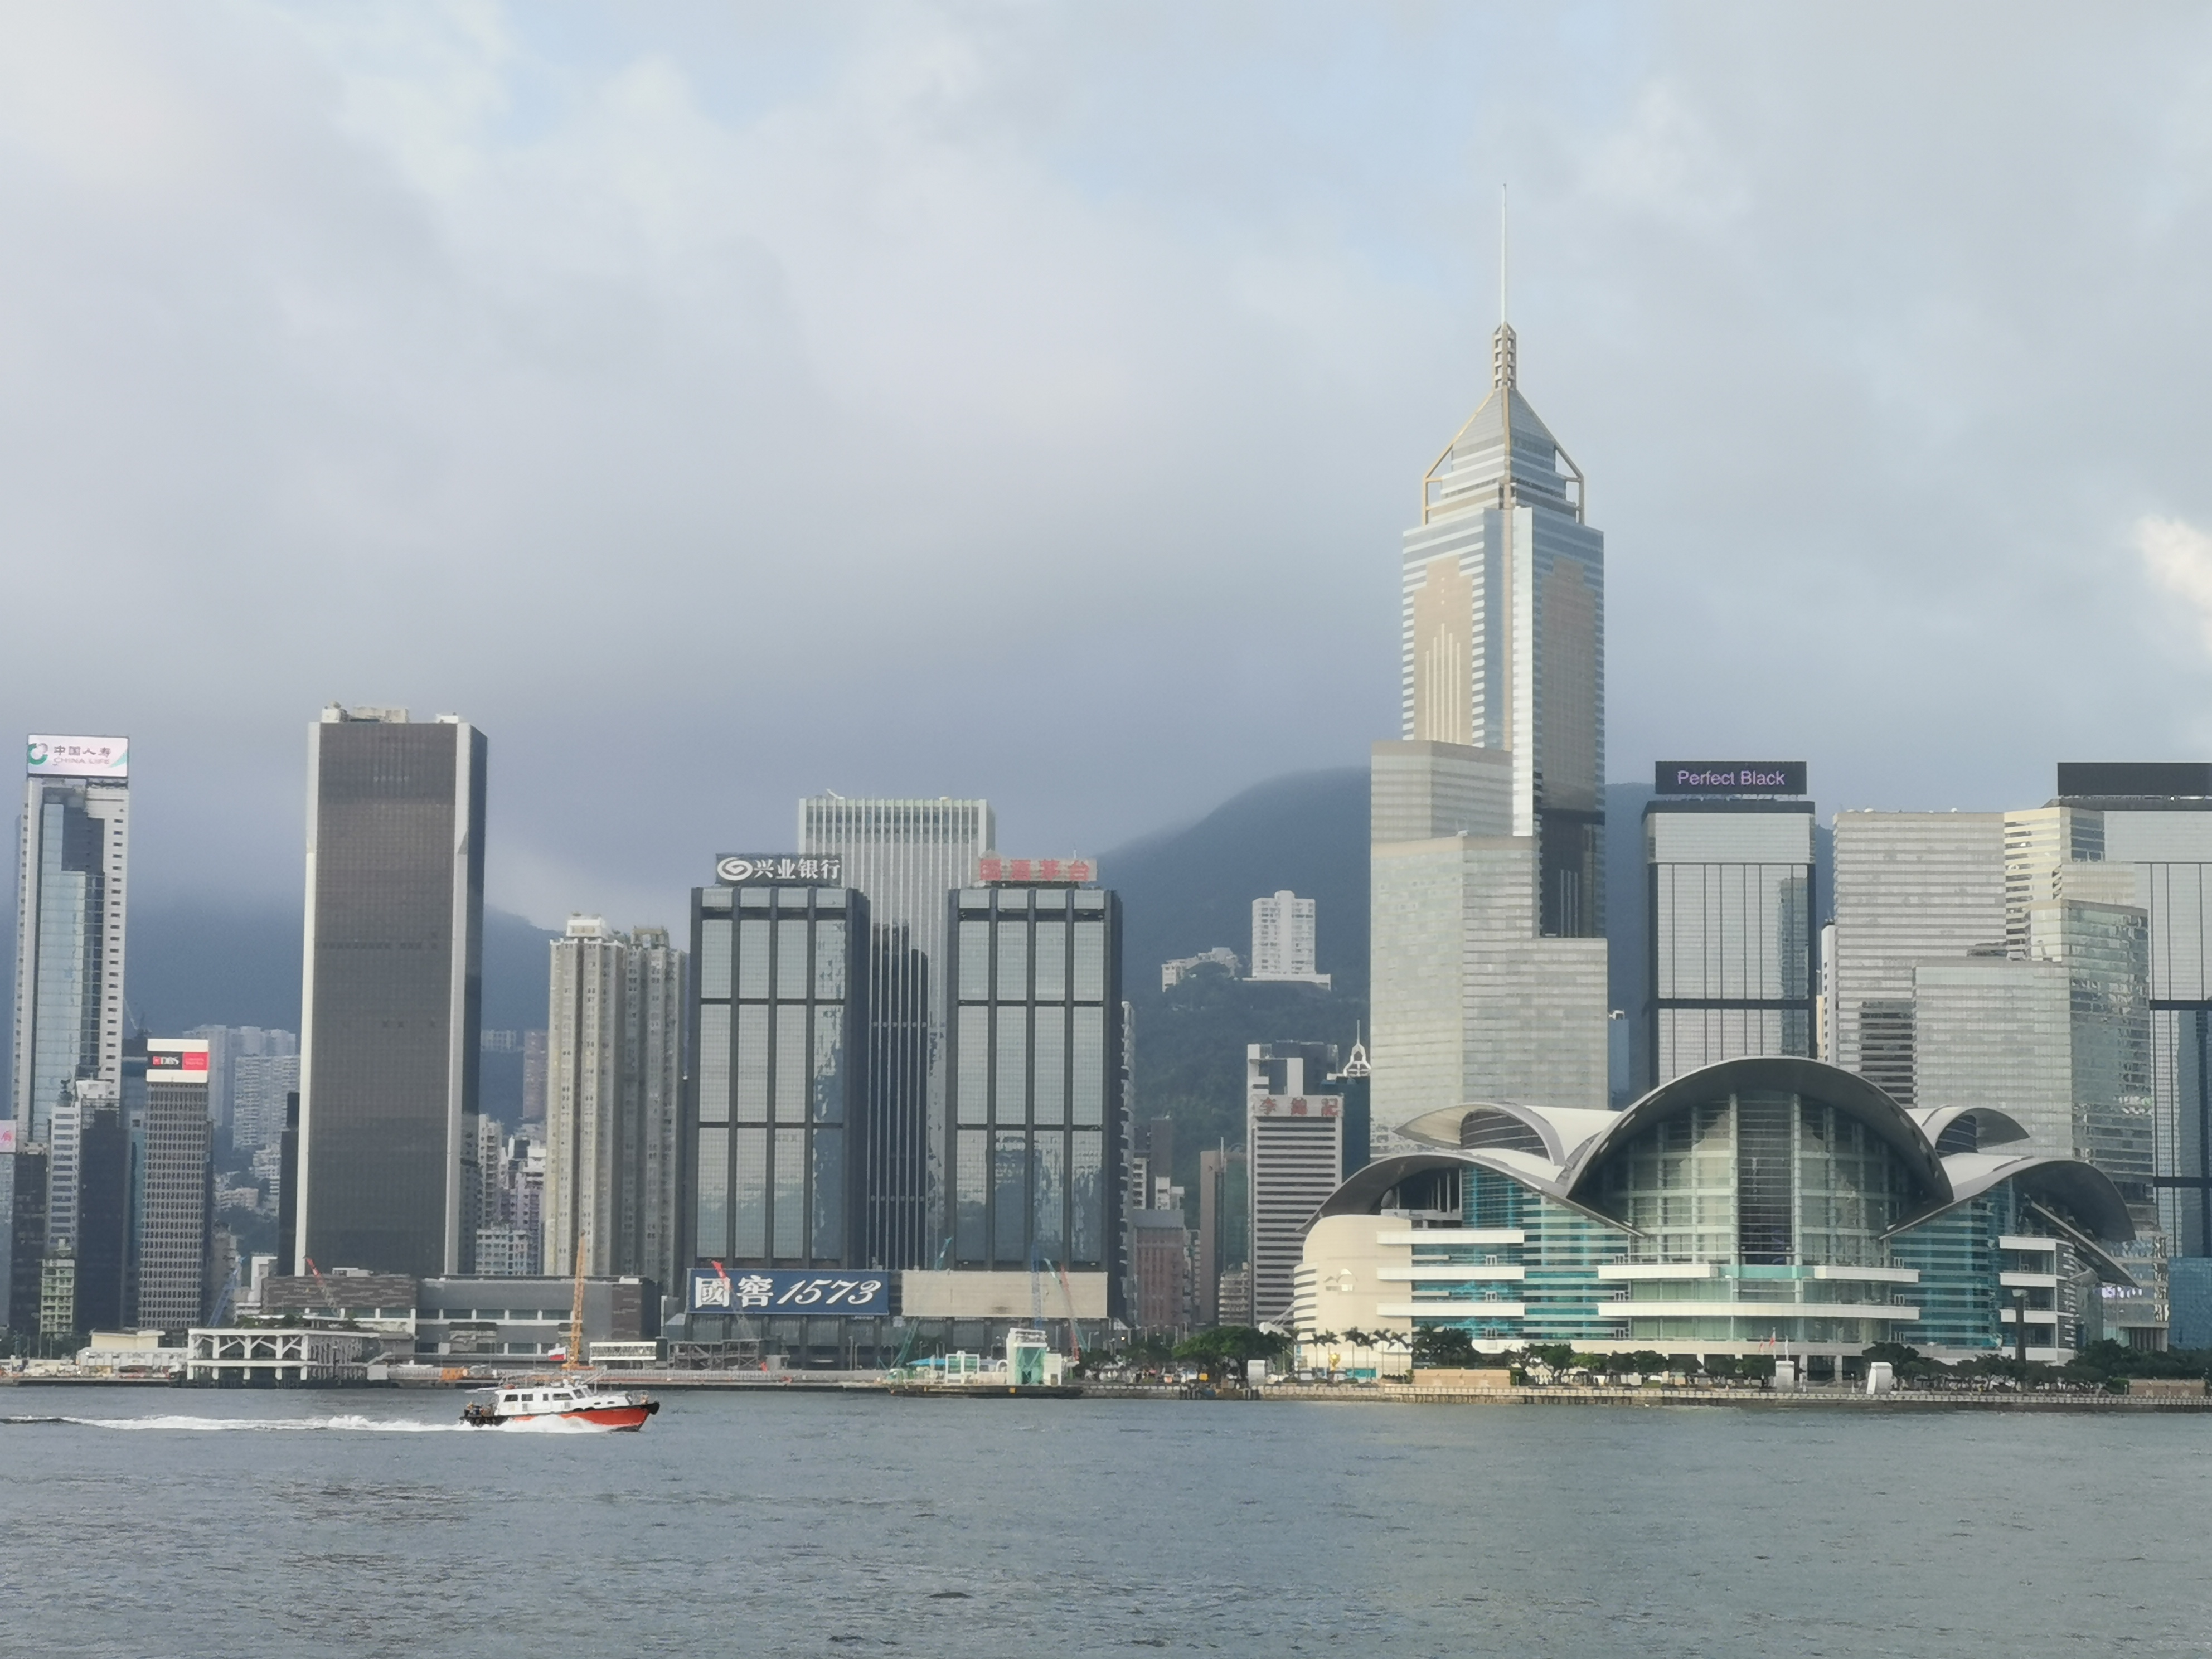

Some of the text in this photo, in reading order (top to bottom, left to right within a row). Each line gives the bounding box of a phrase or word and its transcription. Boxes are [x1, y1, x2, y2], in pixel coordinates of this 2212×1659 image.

[54, 745, 111, 757] 中国人寿
[1677, 770, 1786, 785] Perfect Black
[754, 858, 840, 879] 兴业银行
[160, 1056, 179, 1065] DBS
[695, 1275, 881, 1308] 國窖 1573
